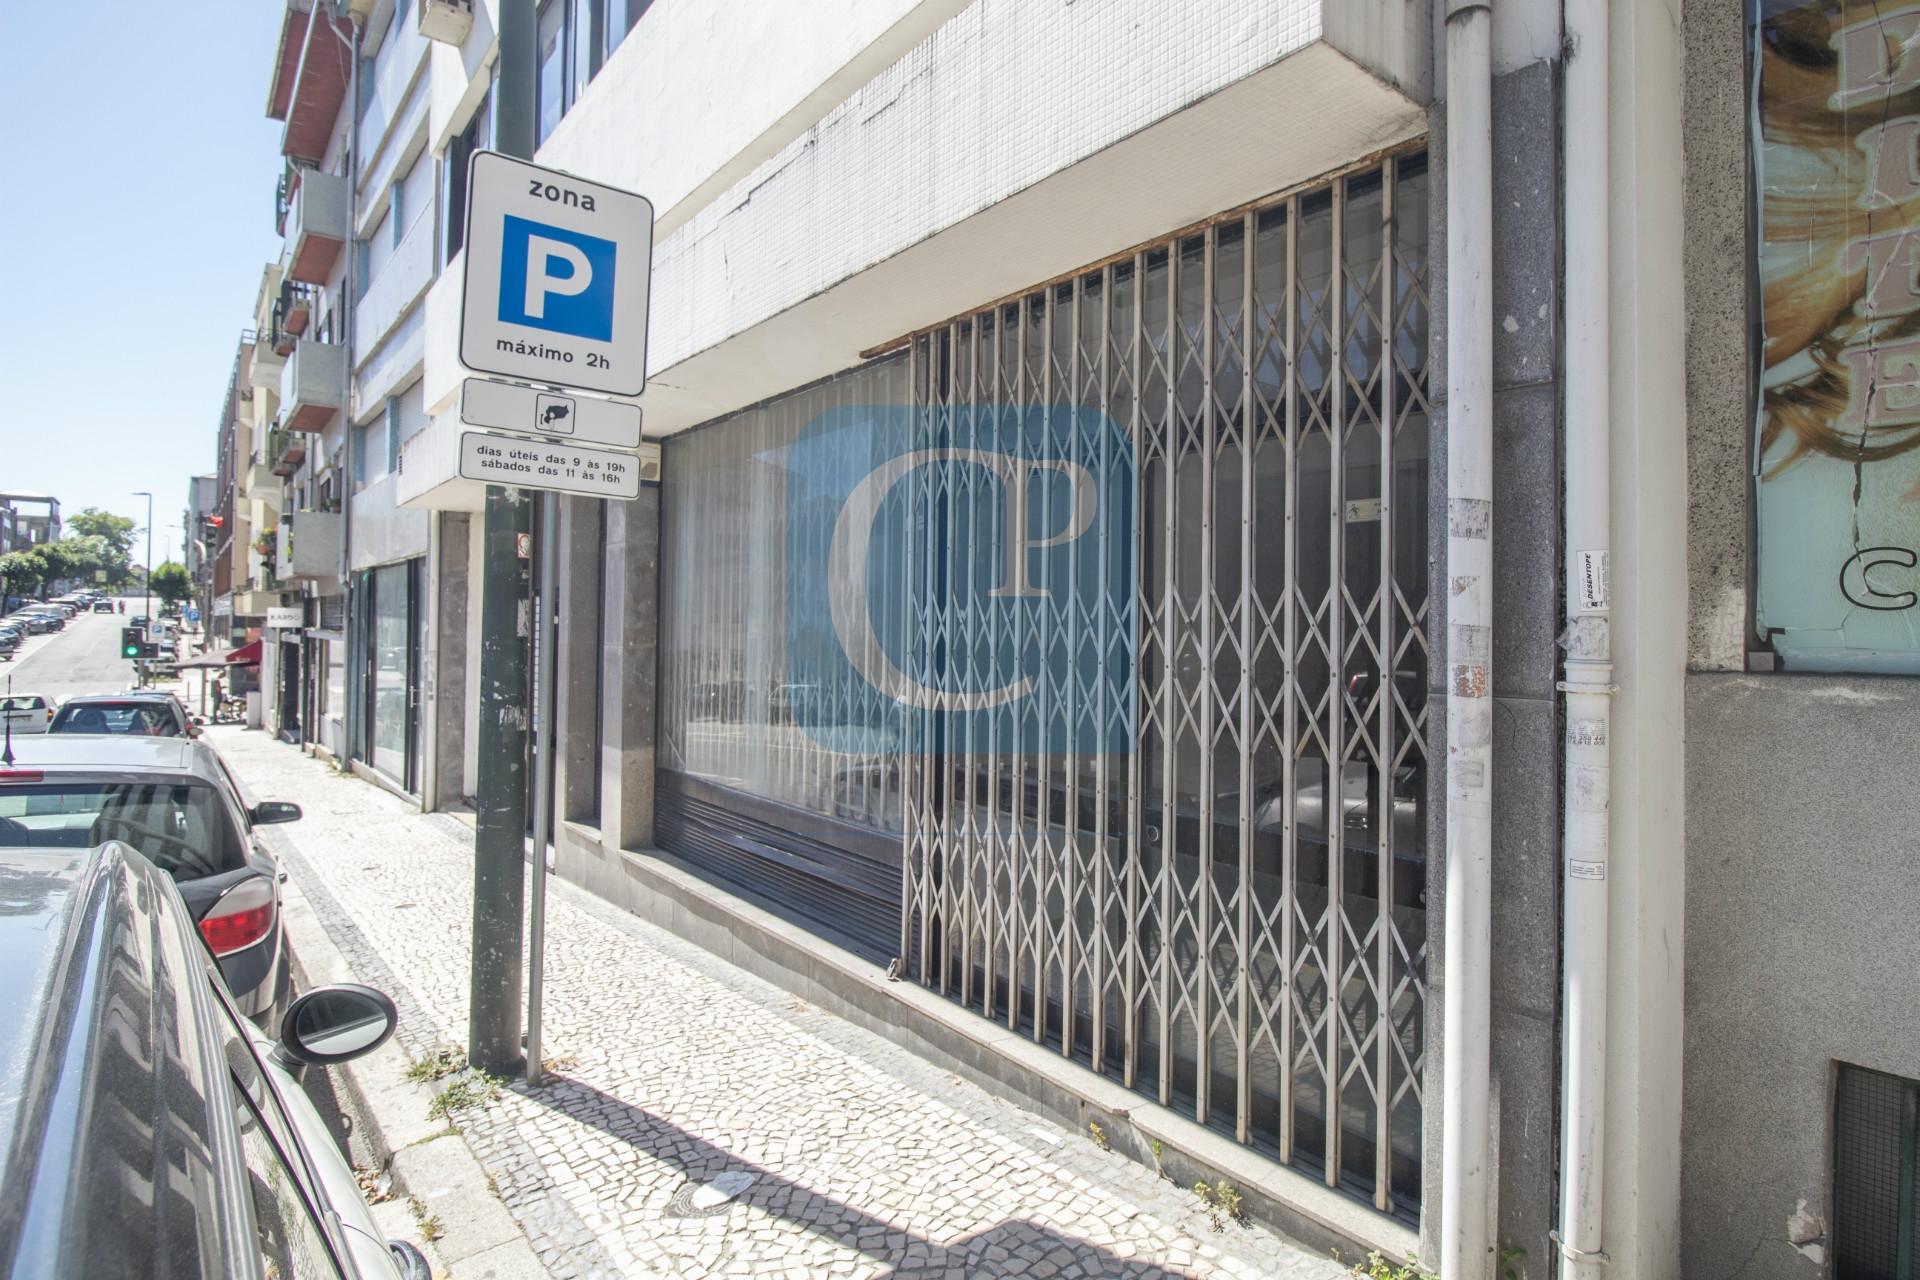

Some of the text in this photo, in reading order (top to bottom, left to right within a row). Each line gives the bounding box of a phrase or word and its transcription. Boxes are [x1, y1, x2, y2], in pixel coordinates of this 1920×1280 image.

[528, 180, 596, 212] zona
[524, 233, 593, 320] P
[496, 339, 610, 370] máximo 2h
[477, 445, 626, 473] dias úteis das 9 às 19h
[481, 458, 620, 484] sábados das 11 às 16h
[1584, 552, 1594, 600] DESENTOPE
